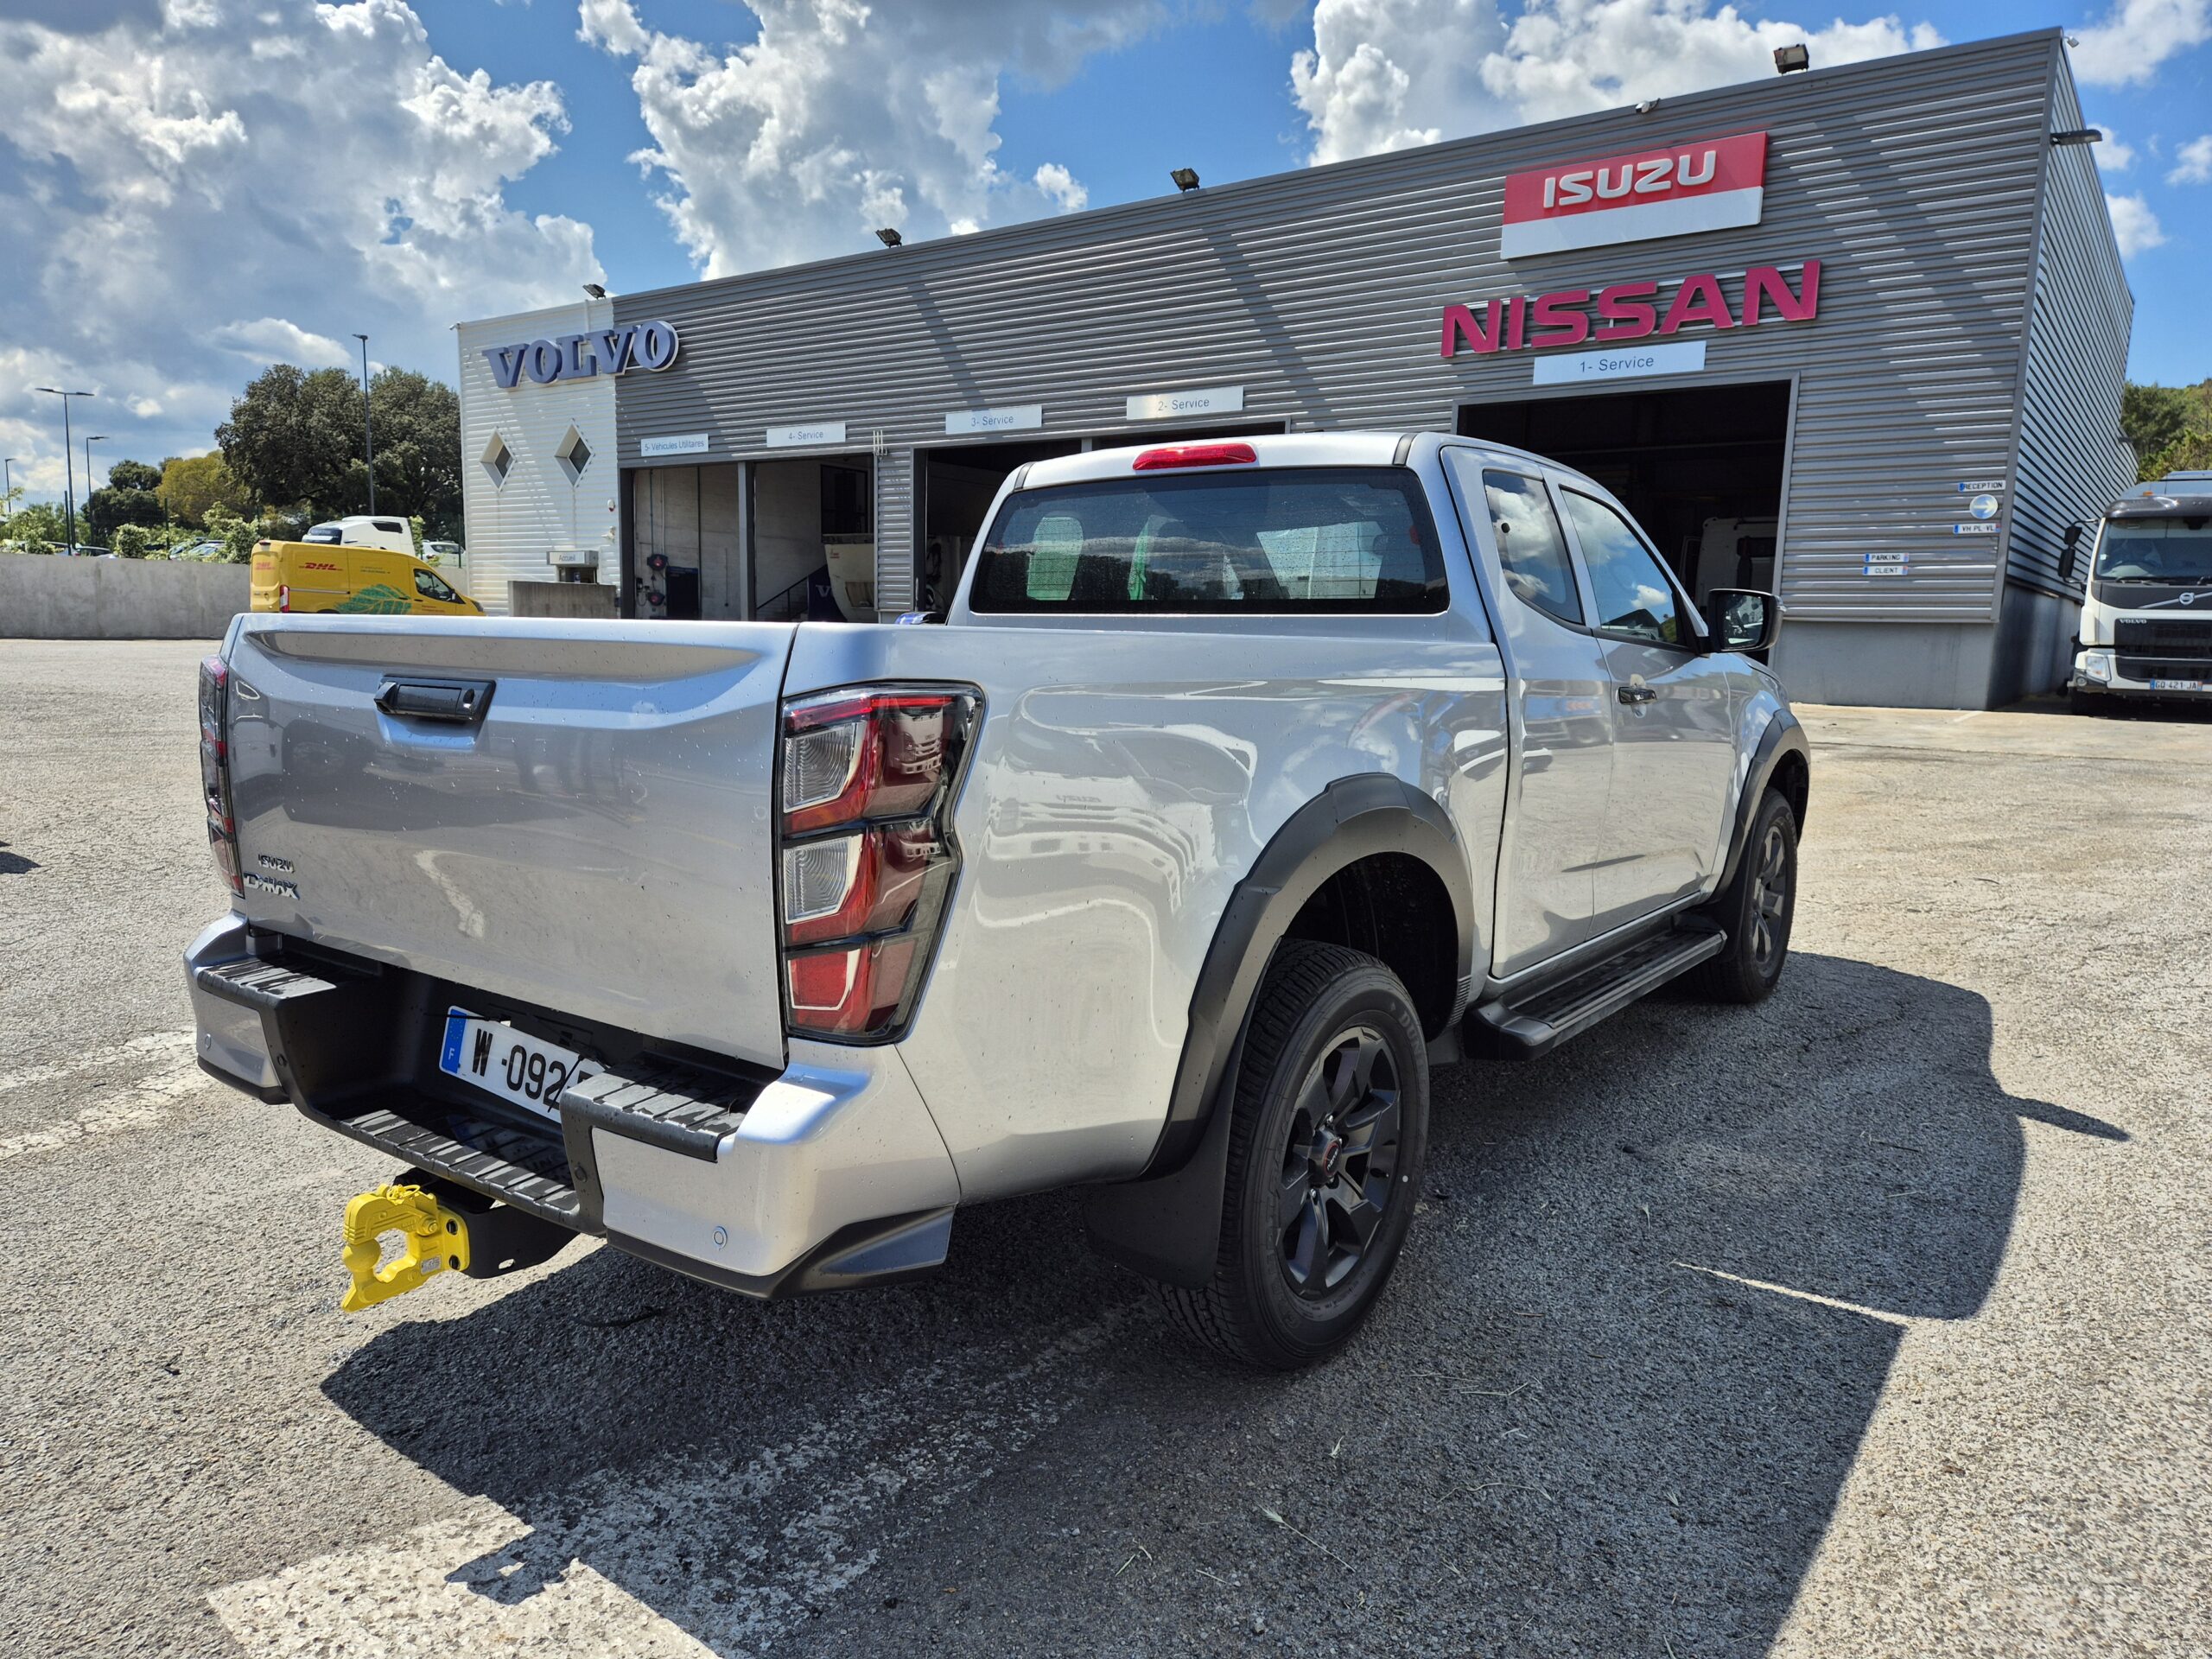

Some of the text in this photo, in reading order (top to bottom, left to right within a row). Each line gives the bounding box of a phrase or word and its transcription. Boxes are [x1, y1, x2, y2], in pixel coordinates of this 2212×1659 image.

[1543, 149, 1717, 208] ISUZU
[1440, 259, 1821, 358] NISSAN
[481, 320, 680, 389] VOLVO
[1599, 356, 1655, 372] Service
[1172, 398, 1210, 410] Service
[982, 416, 1014, 426] Service
[798, 431, 823, 440] Service
[678, 440, 704, 448] Utilitaires
[304, 562, 337, 571] DHL
[258, 854, 296, 874] ISUZU
[448, 1047, 454, 1061] F
